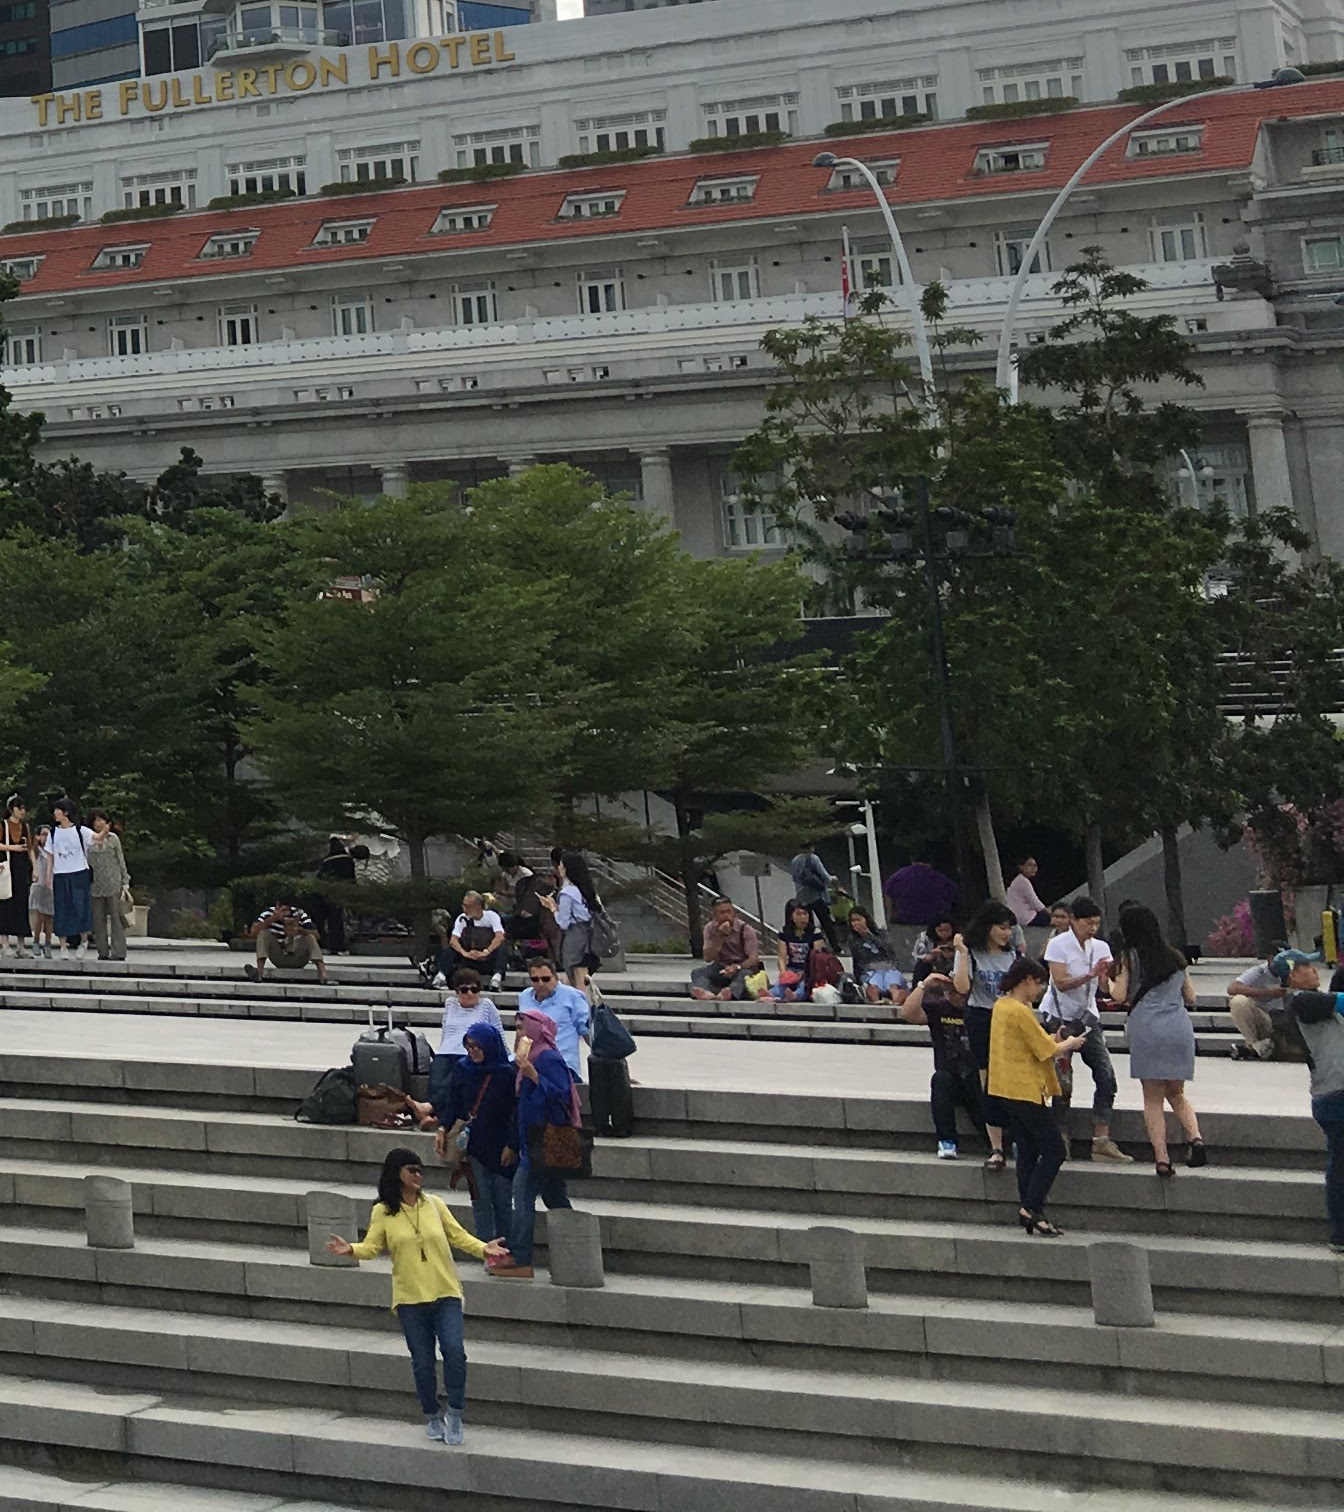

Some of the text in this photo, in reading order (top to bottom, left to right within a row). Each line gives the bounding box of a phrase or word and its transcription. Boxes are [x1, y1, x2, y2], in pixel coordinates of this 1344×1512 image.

[31, 30, 516, 127] THE FULLERTON HOTEL
